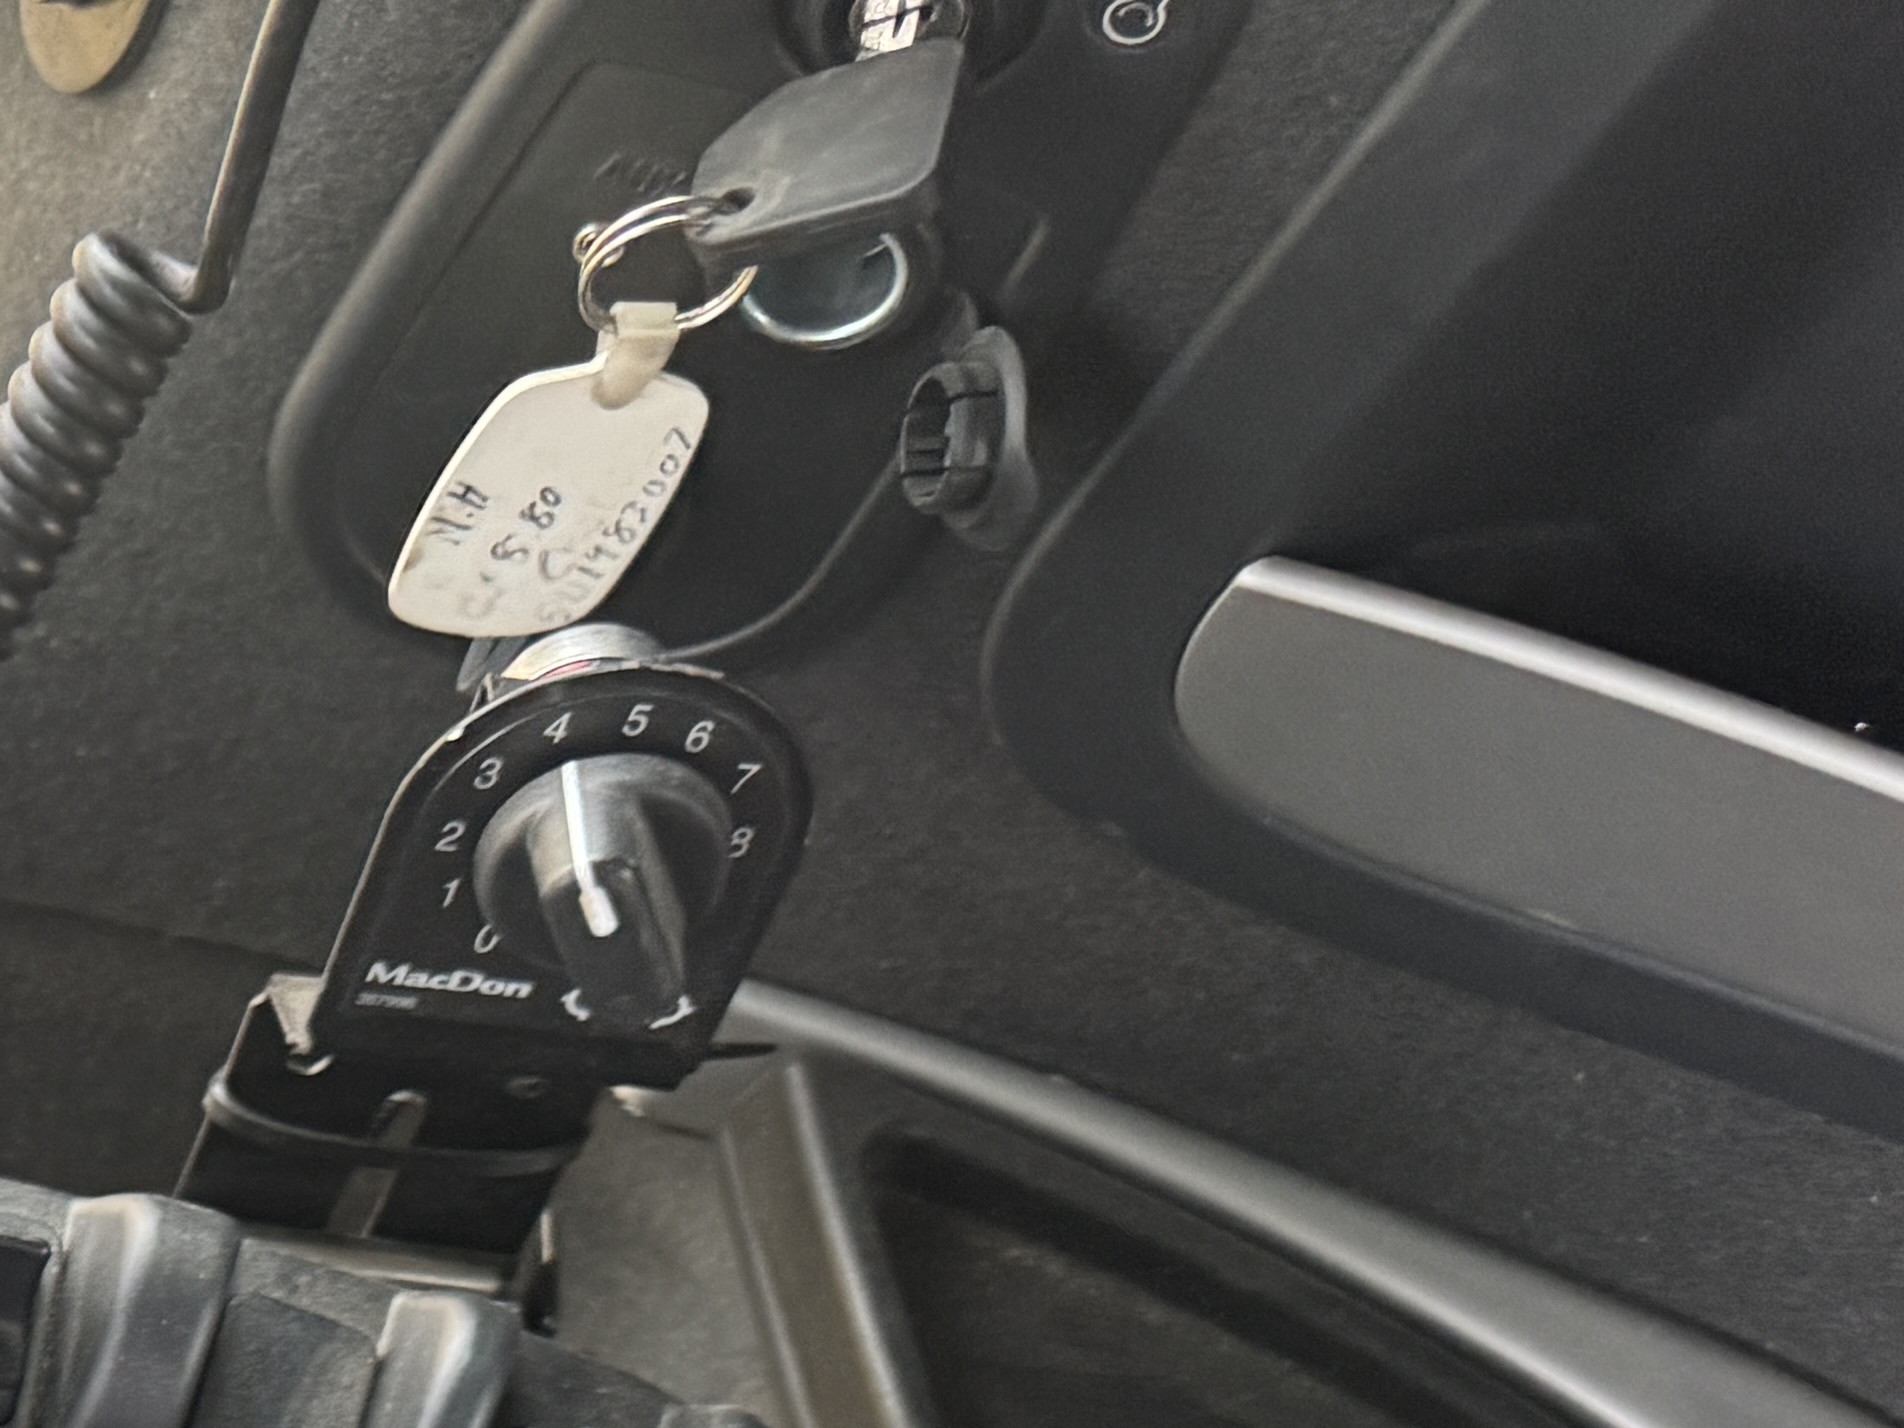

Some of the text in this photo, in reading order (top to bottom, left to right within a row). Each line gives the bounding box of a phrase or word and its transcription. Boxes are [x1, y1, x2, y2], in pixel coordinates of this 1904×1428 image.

[543, 712, 572, 743] 4
[622, 704, 654, 736] 5
[685, 720, 715, 752] 6
[474, 756, 503, 790] 3
[730, 763, 763, 794] 7
[436, 822, 466, 852] 2
[443, 877, 461, 908] 1
[365, 962, 534, 998] MacDon
